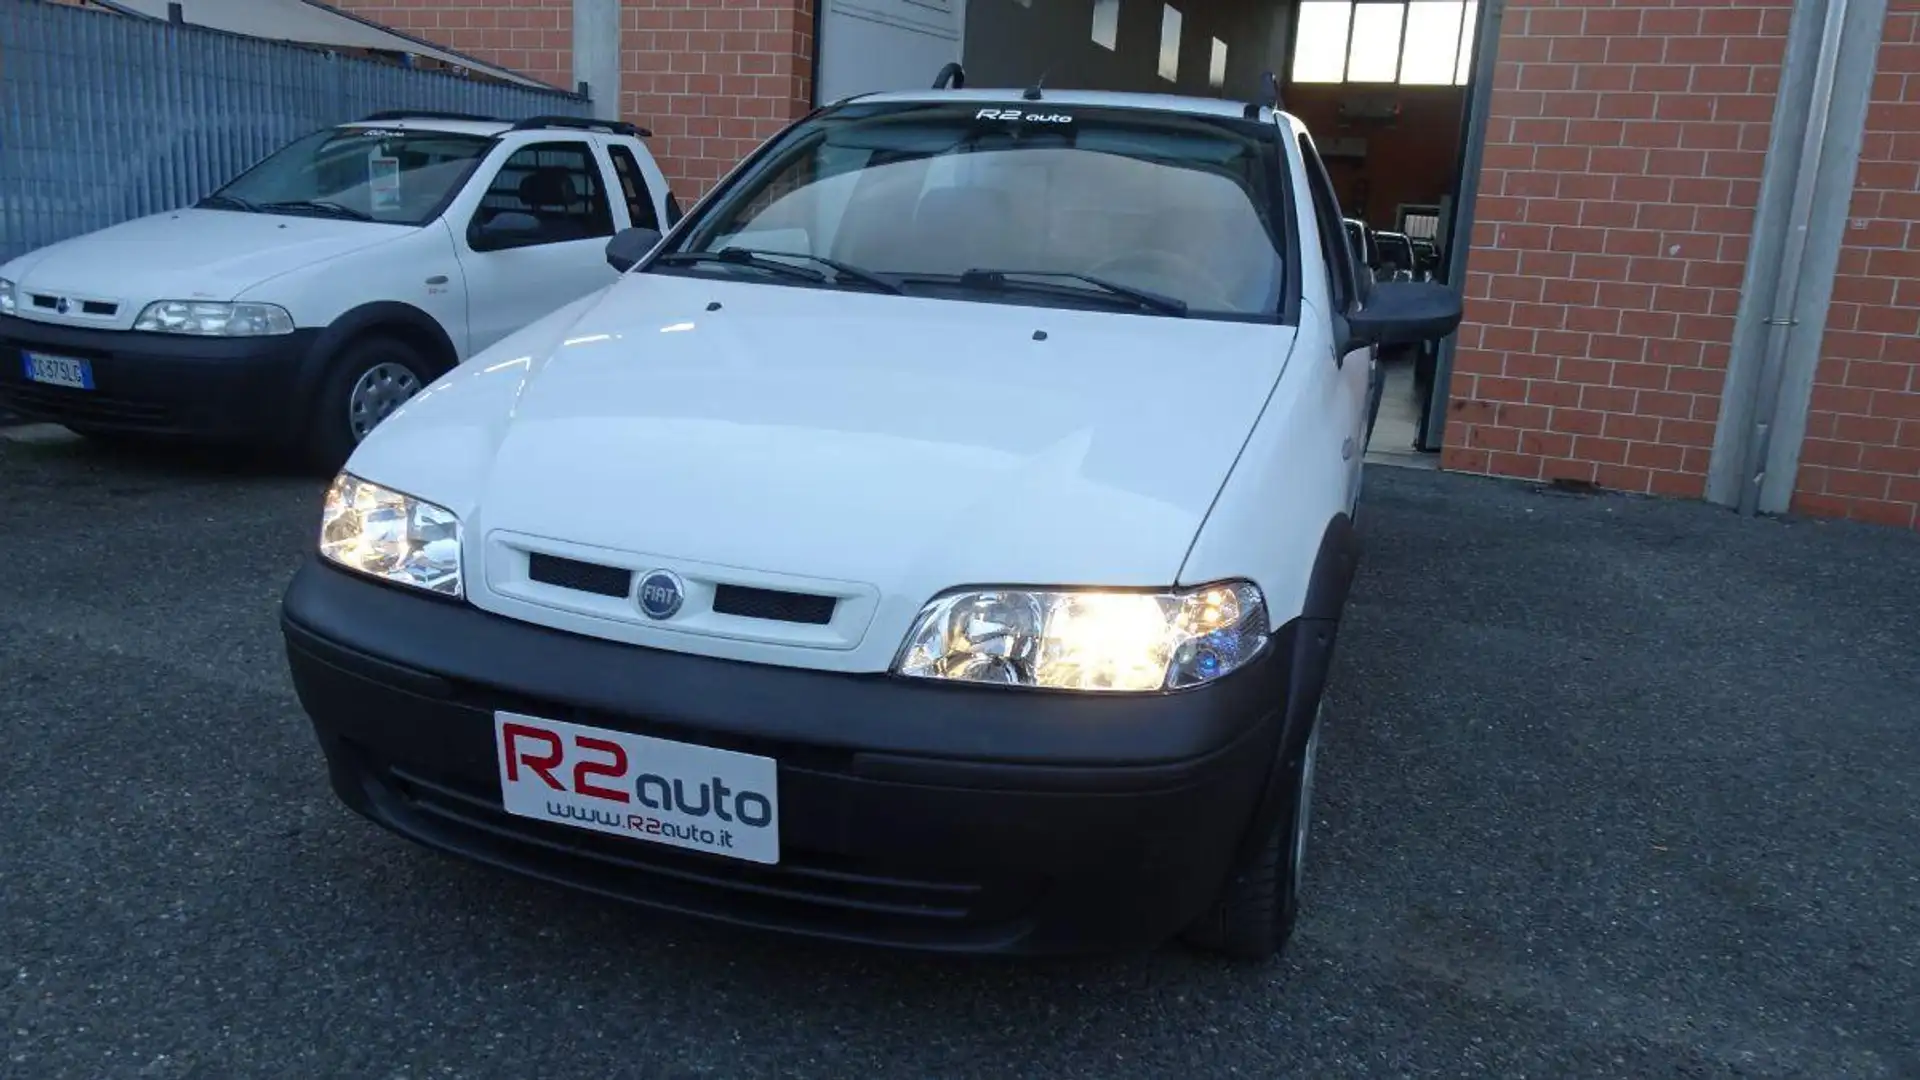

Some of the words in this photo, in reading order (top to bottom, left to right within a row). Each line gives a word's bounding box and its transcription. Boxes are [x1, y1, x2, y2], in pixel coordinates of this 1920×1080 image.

[976, 108, 1022, 120] R2
[1026, 113, 1073, 123] auto
[644, 584, 675, 605] FIAT
[546, 800, 734, 849] www.R2auto.it
